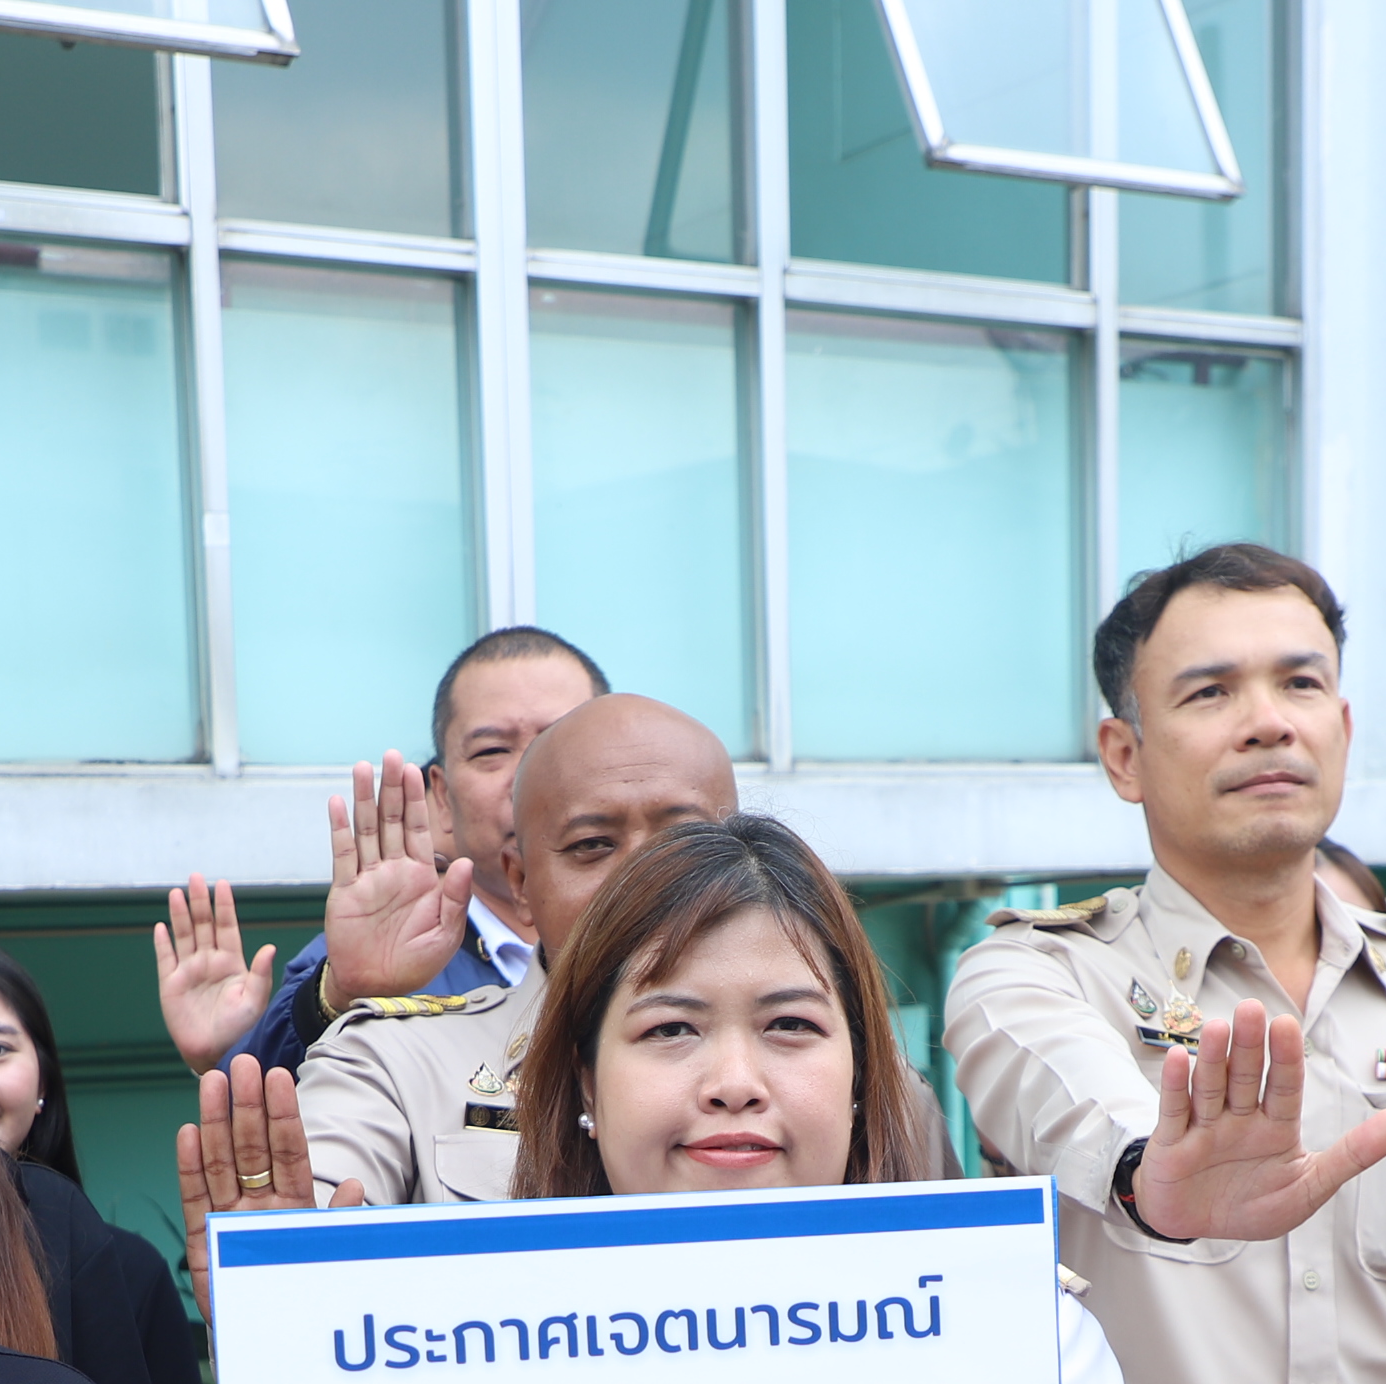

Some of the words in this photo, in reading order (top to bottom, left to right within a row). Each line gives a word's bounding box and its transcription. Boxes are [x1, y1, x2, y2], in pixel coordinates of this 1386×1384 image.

[333, 1273, 944, 1373] ประกาศเจตนารมณ์
